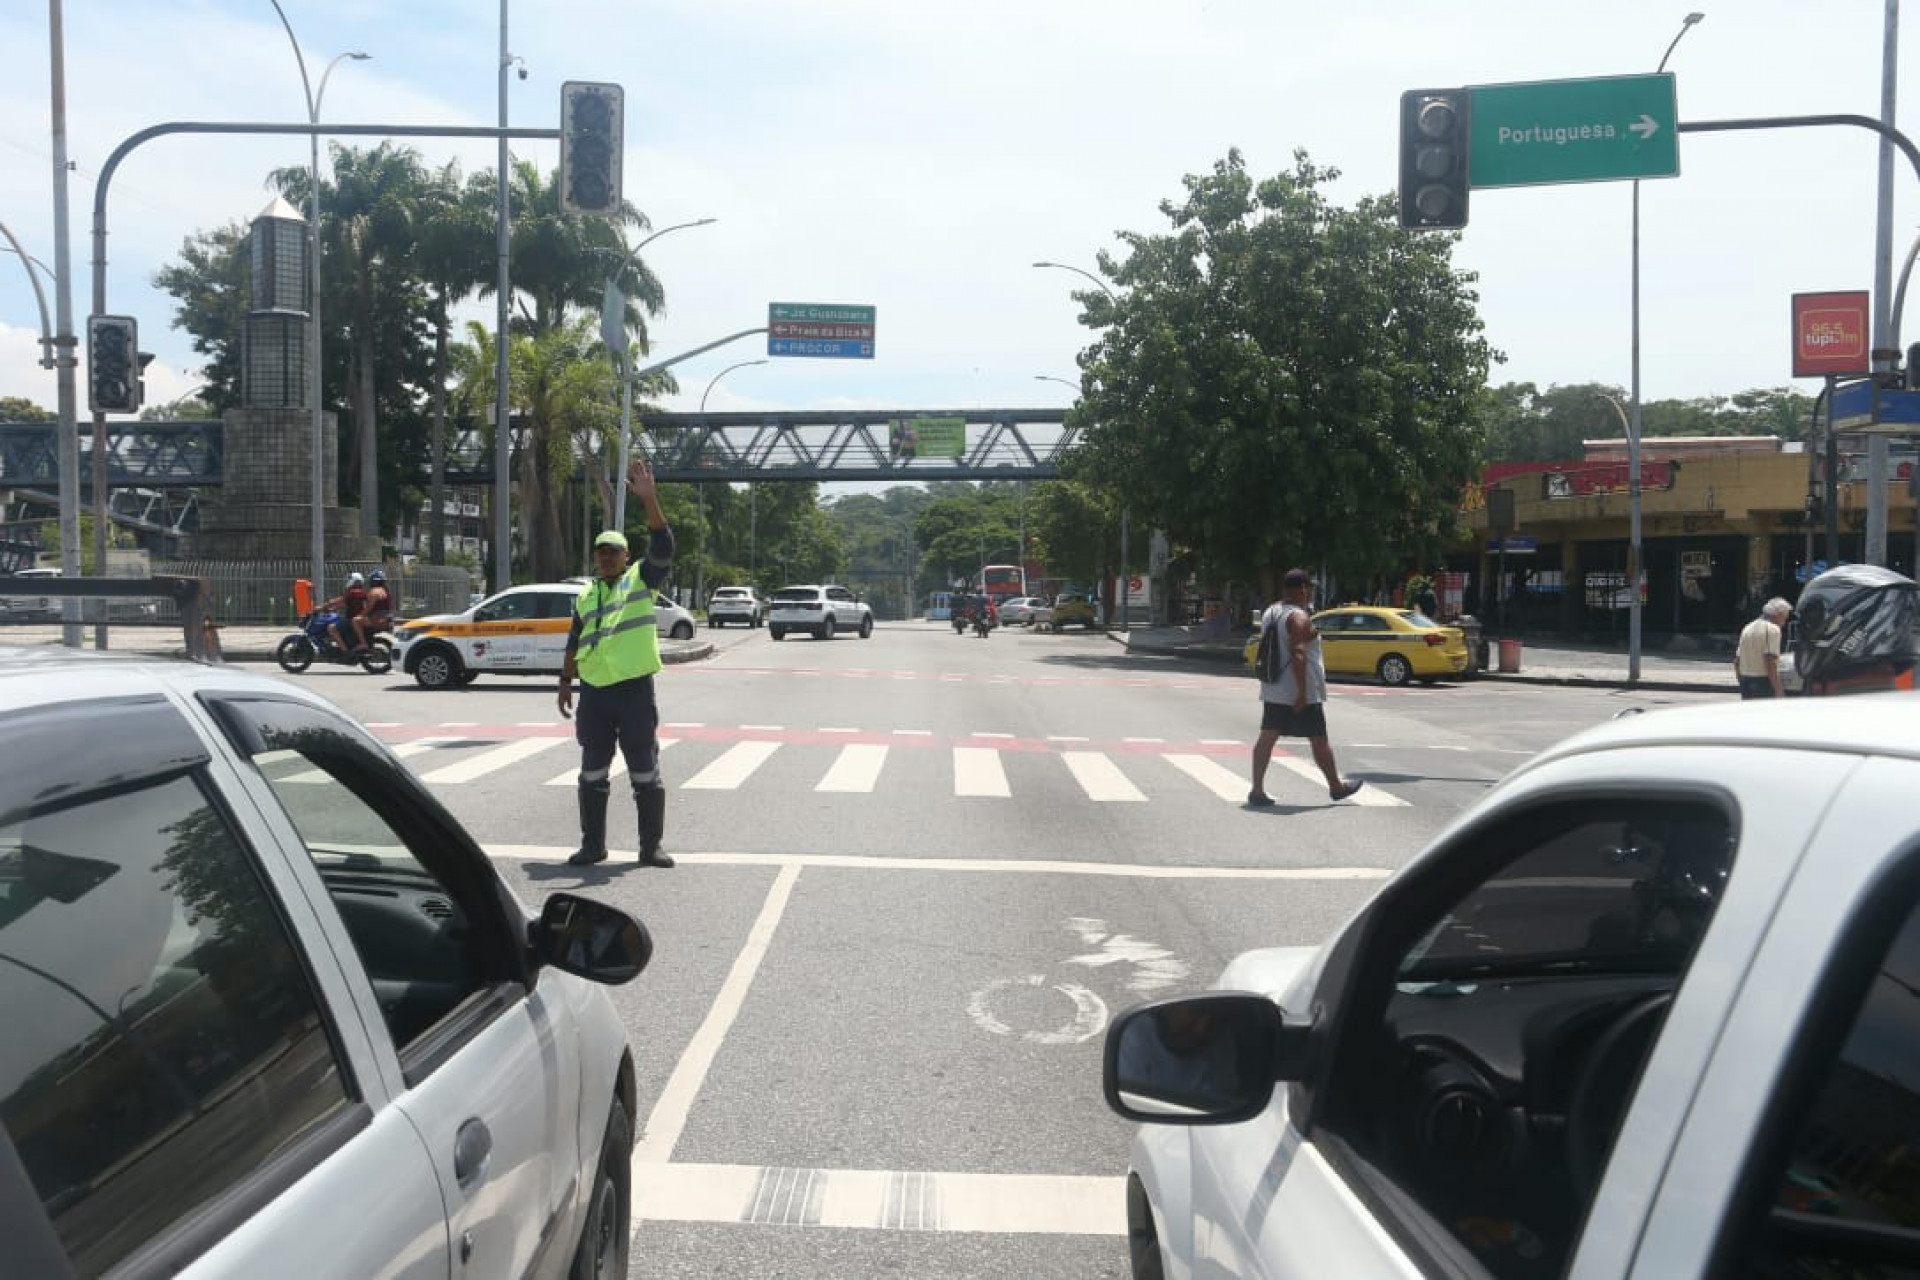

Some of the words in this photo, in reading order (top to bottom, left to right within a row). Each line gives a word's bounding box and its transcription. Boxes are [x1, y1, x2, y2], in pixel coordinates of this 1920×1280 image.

[1498, 122, 1616, 145] Portuguesa
[789, 325, 819, 336] Praia
[836, 327, 860, 337] Bica
[1811, 322, 1844, 335] 96.5
